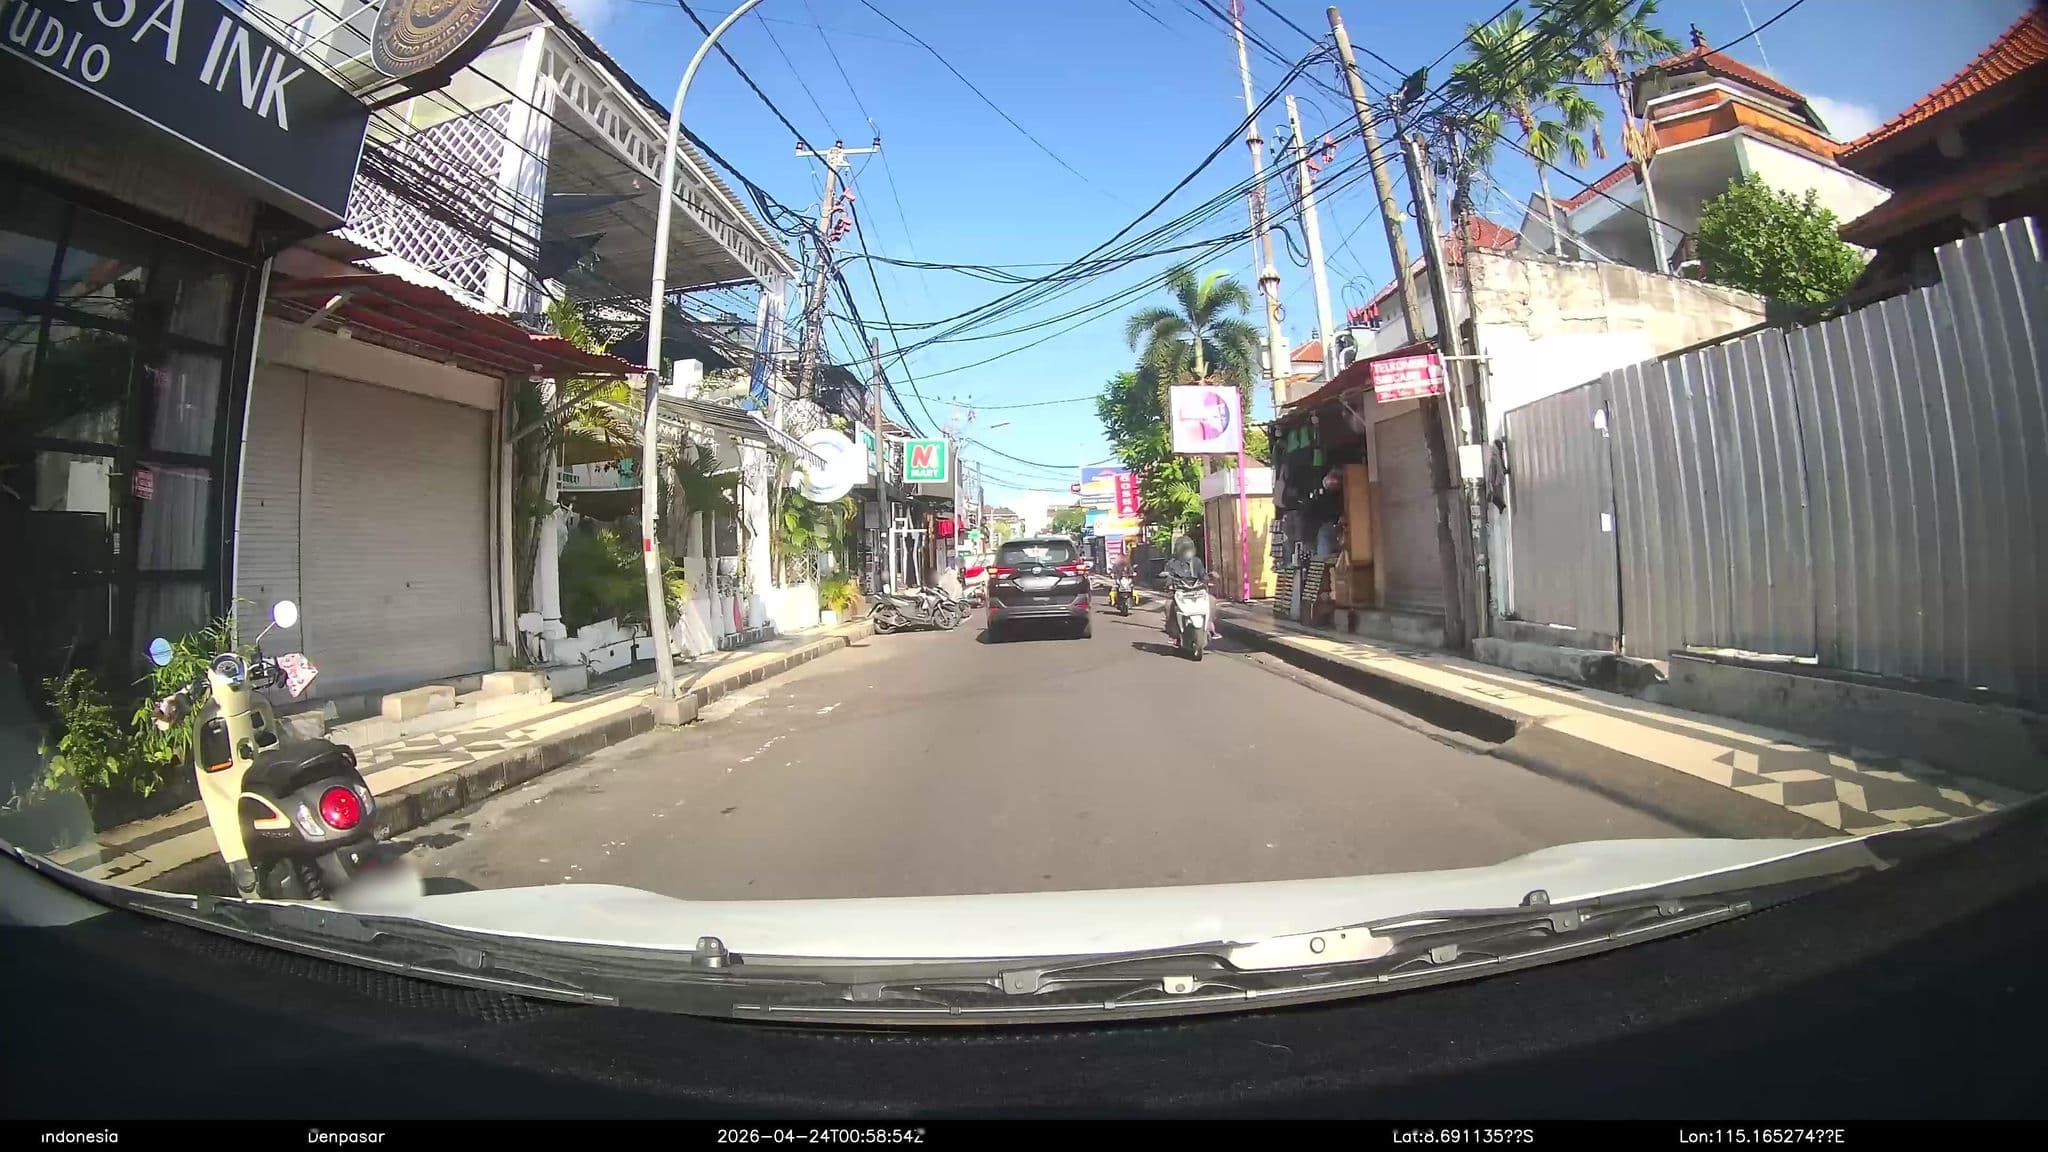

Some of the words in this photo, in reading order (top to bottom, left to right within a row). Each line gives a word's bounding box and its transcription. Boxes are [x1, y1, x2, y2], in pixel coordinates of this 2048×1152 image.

[8, 0, 110, 83] UDIO
[422, 13, 469, 49] STUDIO
[199, 15, 305, 131] INK
